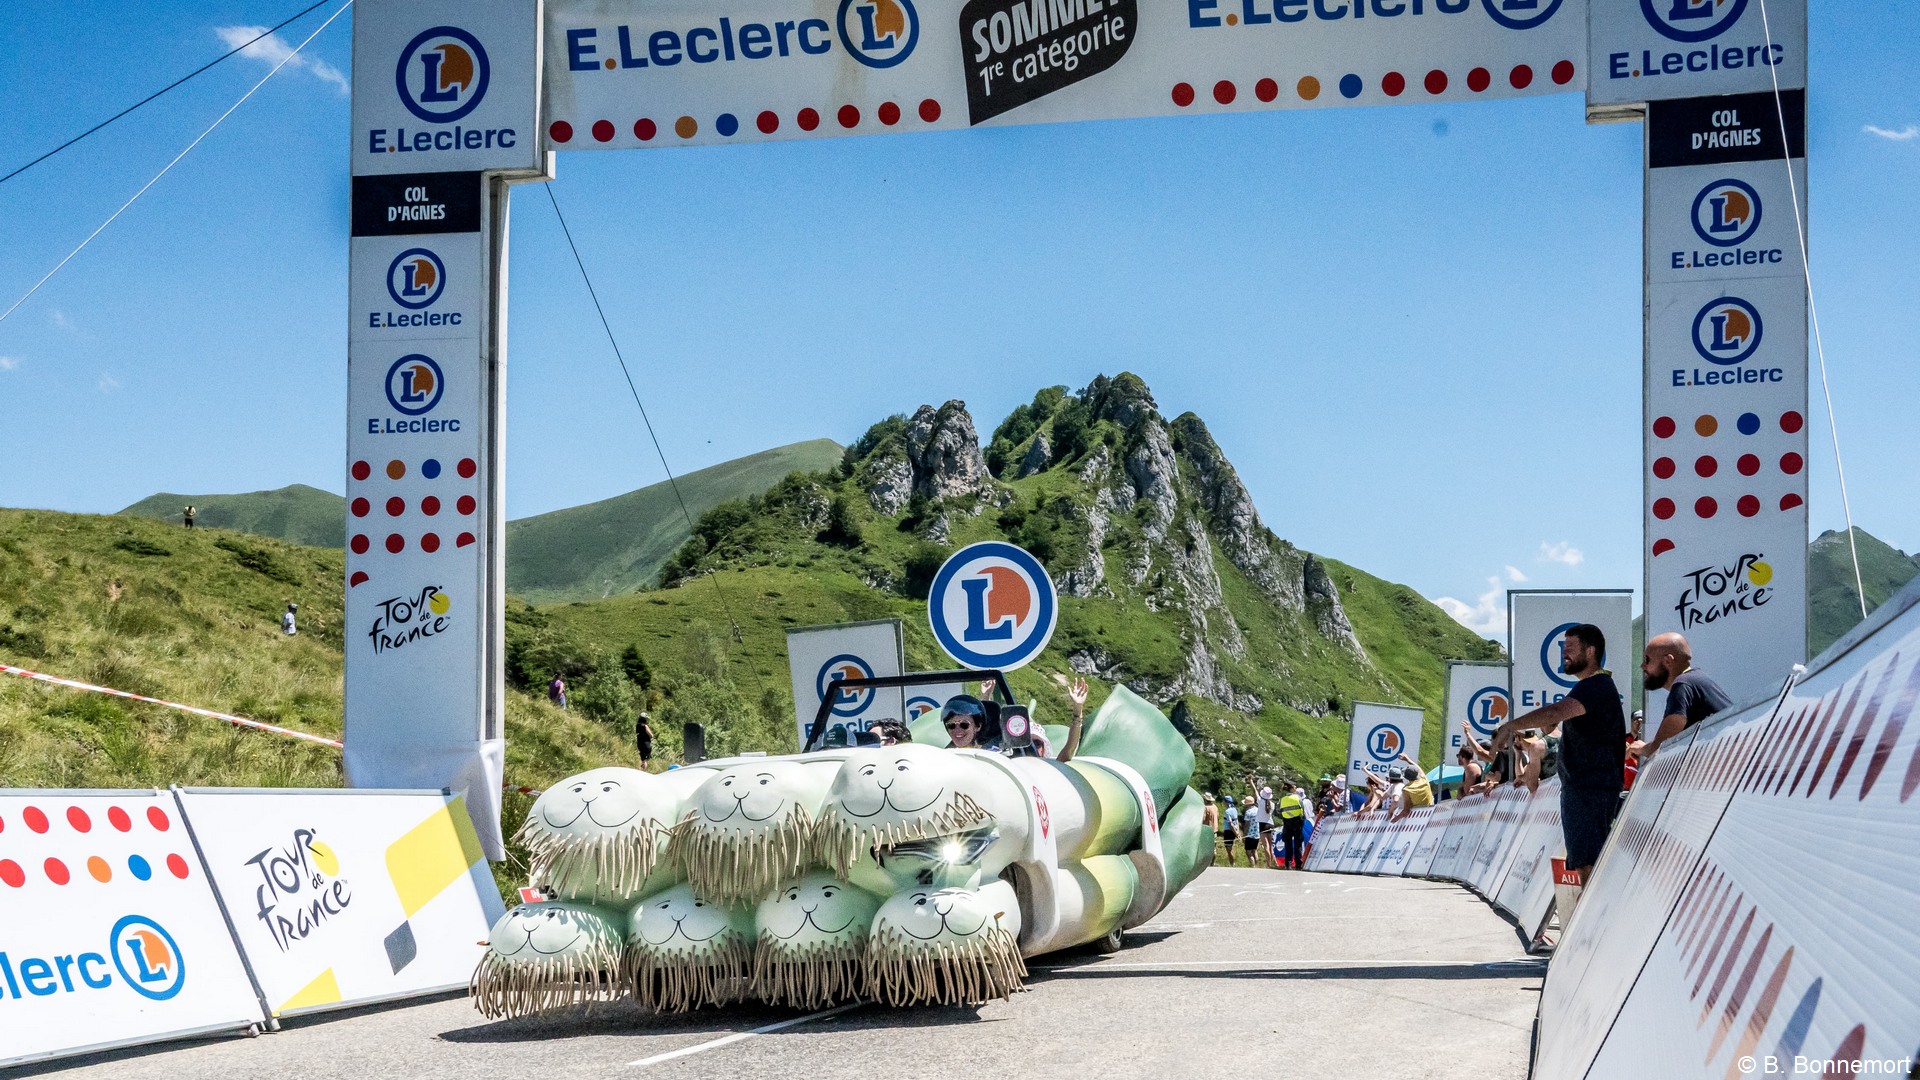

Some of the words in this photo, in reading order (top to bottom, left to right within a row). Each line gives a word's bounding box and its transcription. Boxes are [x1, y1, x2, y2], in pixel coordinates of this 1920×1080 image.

[972, 0, 1119, 63] SOMM
[567, 17, 832, 71] E.Leclerc
[979, 61, 1004, 96] 1re
[1012, 15, 1125, 83] catégorie
[1609, 43, 1784, 79] E.Leclerc
[1711, 110, 1741, 128] COL
[369, 126, 516, 154] E.Leclerc
[1691, 128, 1761, 149] D'AGNES
[404, 186, 429, 203] COL
[387, 204, 446, 223] D'AGNES
[1671, 247, 1782, 269] E.Leclerc
[369, 310, 462, 328] E.Leclerc
[1672, 367, 1783, 387] E.Leclerc
[368, 417, 461, 434] E.Leclerc
[1736, 580, 1749, 594] de
[419, 609, 431, 622] de
[311, 868, 325, 890] de
